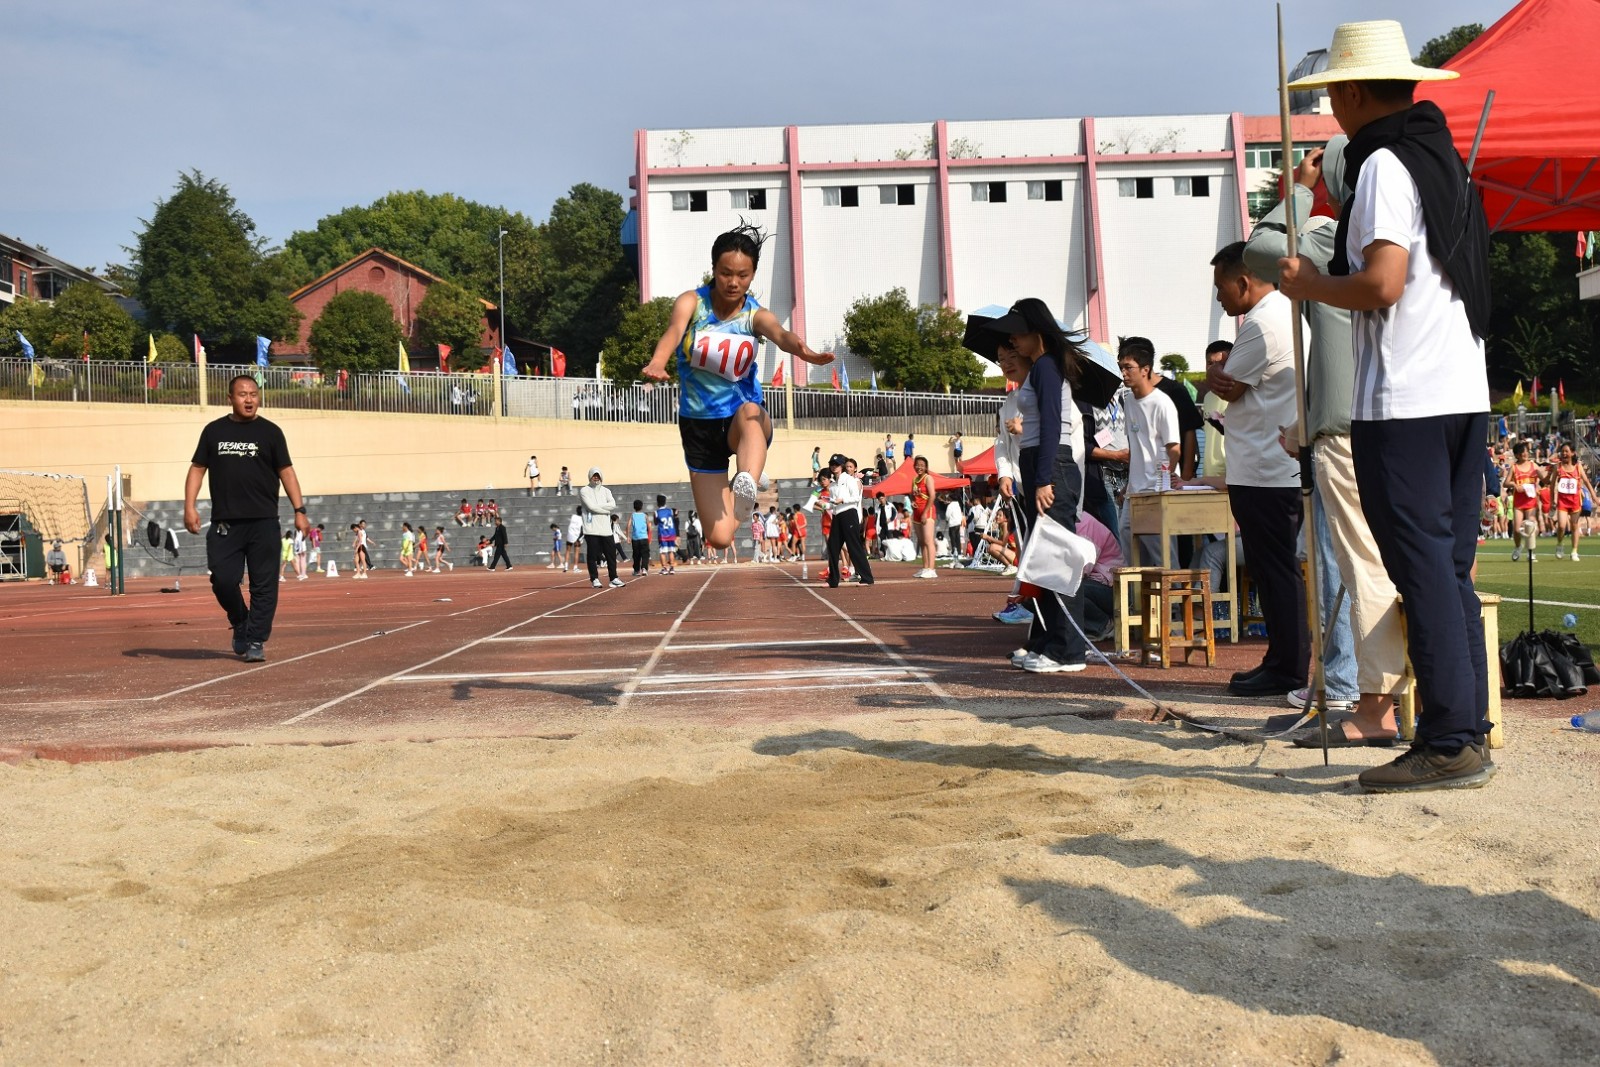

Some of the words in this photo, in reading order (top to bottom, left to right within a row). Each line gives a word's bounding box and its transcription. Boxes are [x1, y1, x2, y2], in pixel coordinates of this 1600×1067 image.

[697, 336, 754, 377] 110
[218, 441, 248, 451] DESIRE
[660, 516, 674, 530] 24
